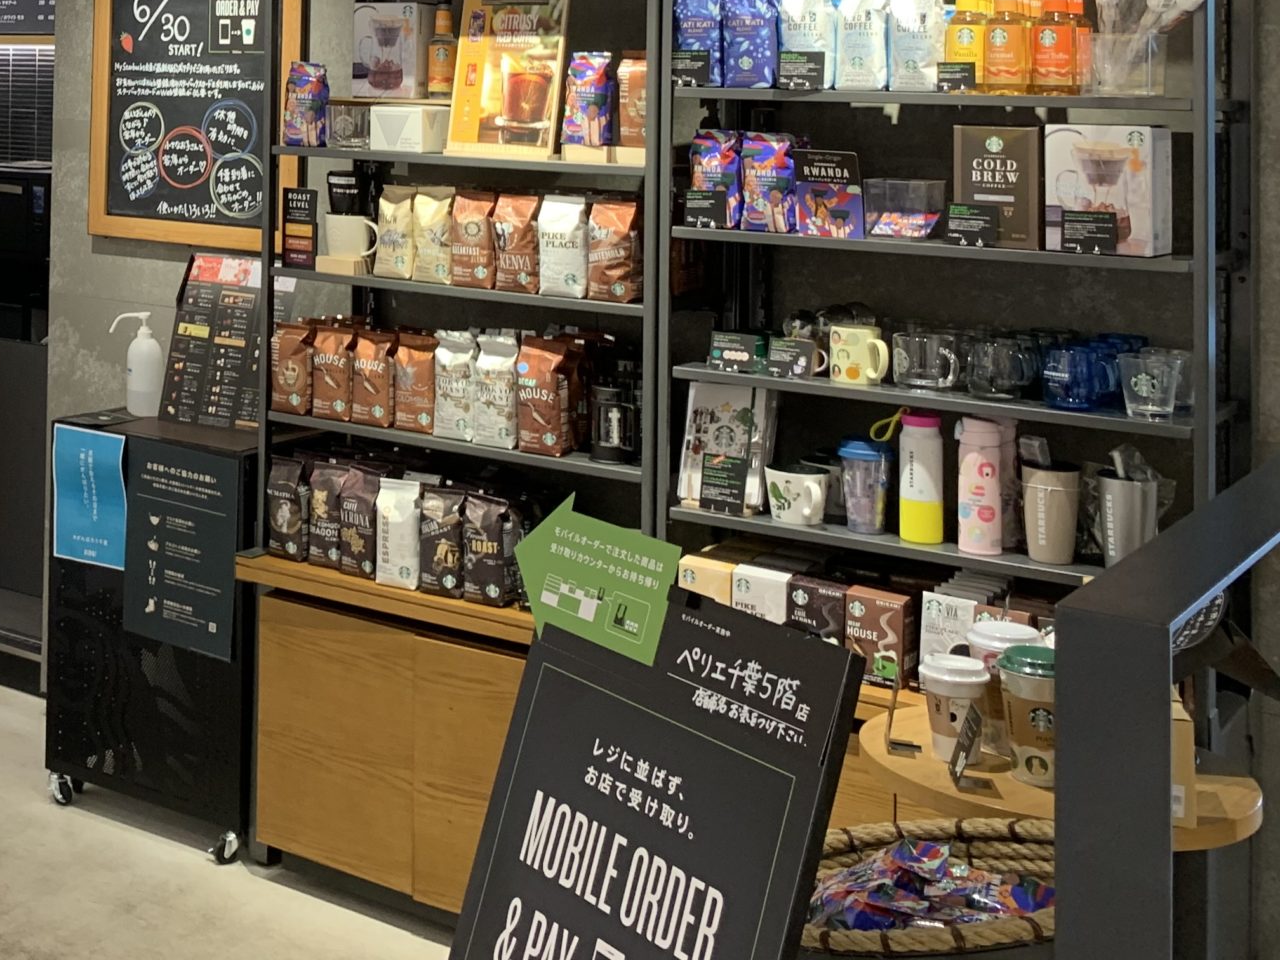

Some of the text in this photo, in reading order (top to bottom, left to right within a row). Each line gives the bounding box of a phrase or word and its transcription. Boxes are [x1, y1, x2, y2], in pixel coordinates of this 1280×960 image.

[215, 0, 260, 16] ORDER & PAY
[499, 14, 539, 30] CITRUSY
[788, 23, 817, 32] COFFEE
[844, 21, 873, 31] COFFEE
[496, 31, 537, 43] ICED COFFEE
[168, 42, 204, 57] START!
[213, 108, 237, 124] 休憩
[803, 166, 850, 178] RWANDA
[972, 158, 1018, 171] COLD
[971, 171, 1020, 184] BREW
[288, 192, 311, 200] ROAST
[289, 200, 309, 208] LEVEL
[541, 232, 566, 240] PIKE
[452, 245, 480, 256] BREAKFAST
[545, 240, 579, 249] PLACE
[500, 253, 531, 271] KENYA
[313, 353, 347, 369] HOUSE
[353, 358, 386, 374] HOUSE
[438, 378, 470, 387] TOKYO
[480, 385, 511, 395] TOKYO
[518, 387, 557, 404] HOUSE
[341, 509, 370, 528] VERONA
[1105, 494, 1116, 557] STARBUCKS
[471, 539, 498, 554] ROAST
[554, 526, 664, 572] モバイルオーダーで注文した商品は
[549, 542, 660, 590] 受け取りカウンターからお持ち帰り
[735, 601, 757, 610] PIKE
[945, 606, 959, 620] VIA
[847, 626, 879, 641] HOUSE
[592, 737, 685, 801] レジに並ばず、
[583, 765, 694, 840] お店で受け取り。
[519, 789, 725, 960] MOBILE ORDER
[492, 896, 580, 960] & PAY
